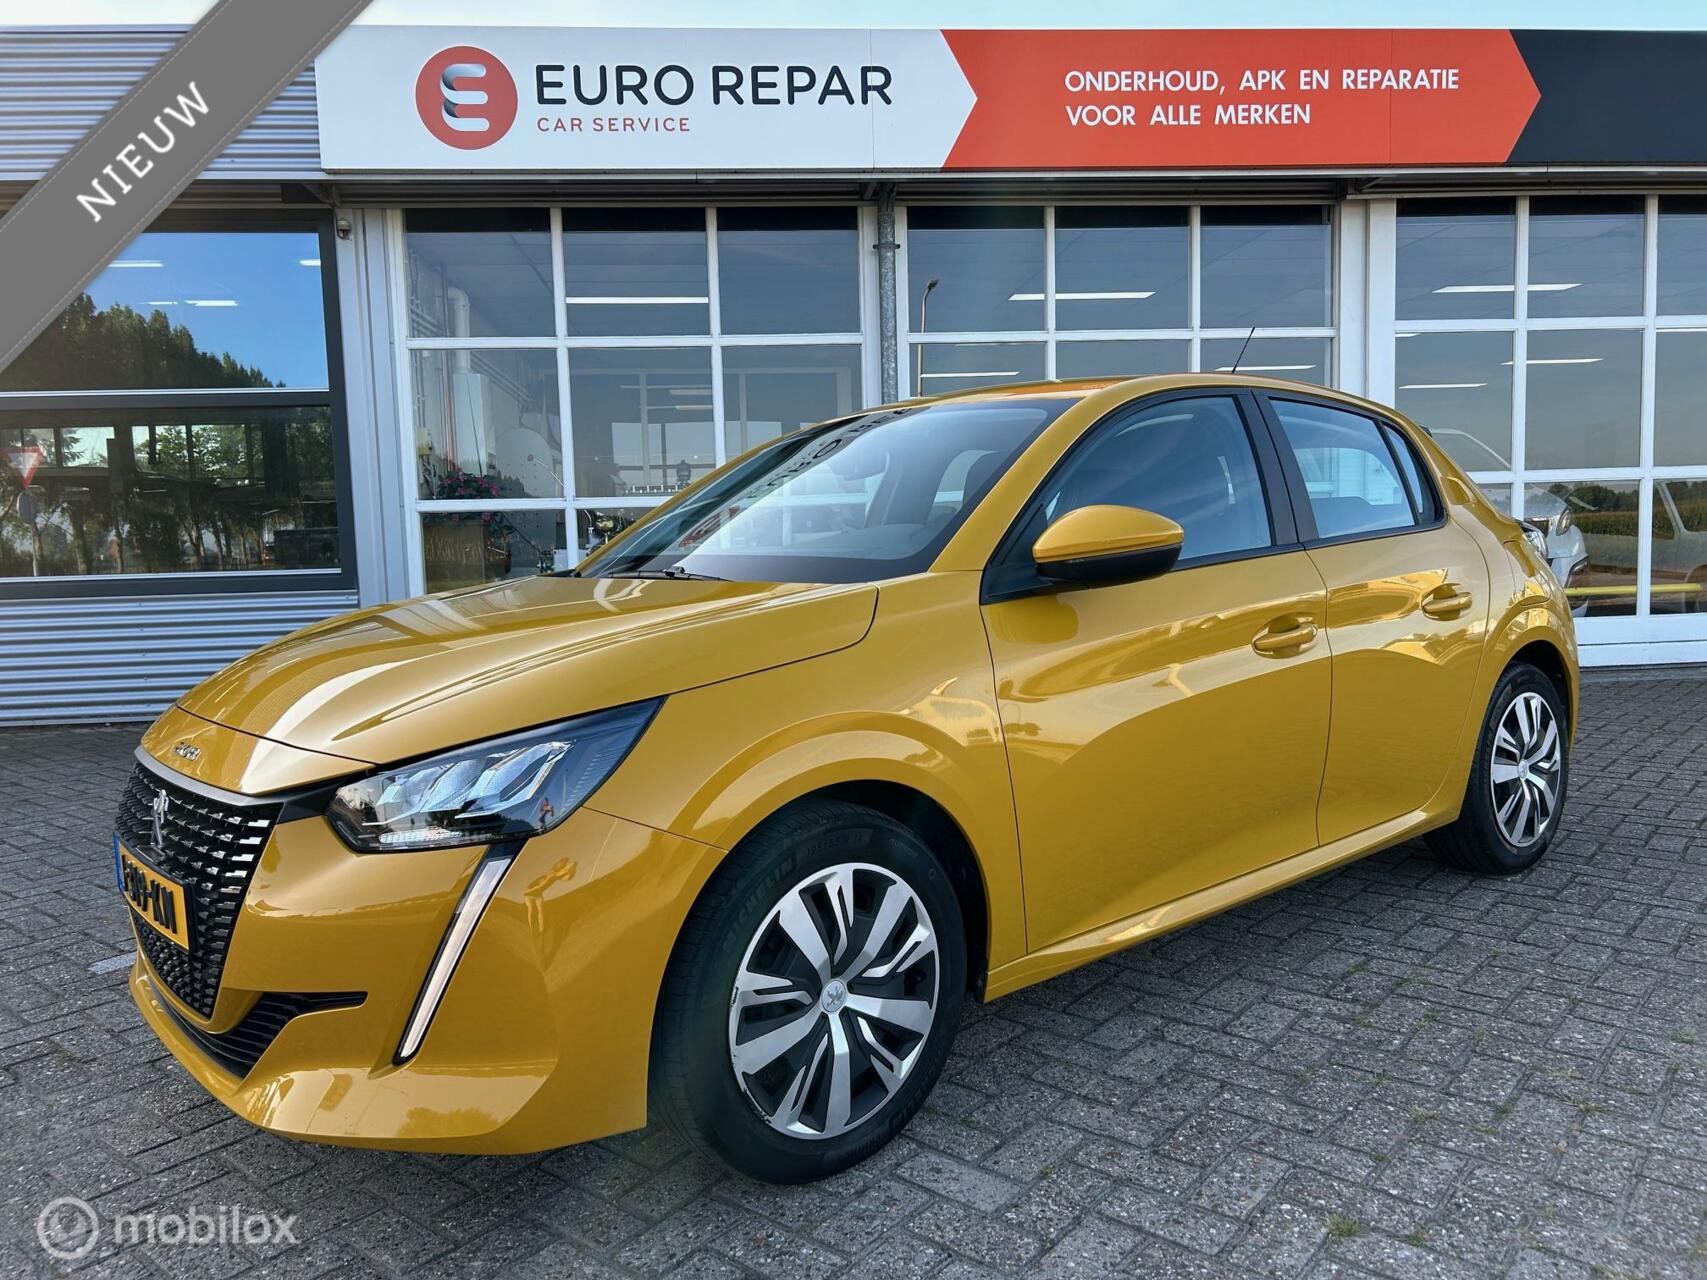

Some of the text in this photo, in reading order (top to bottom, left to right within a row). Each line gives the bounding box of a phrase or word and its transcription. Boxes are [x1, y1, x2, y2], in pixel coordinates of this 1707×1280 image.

[535, 64, 893, 107] EURO REPAR
[1065, 68, 1460, 96] ONDERHOUD, APK EN REPARATIE
[536, 116, 691, 133] CAR SERVICE
[1066, 103, 1312, 127] VOOR ALLE MERKEN
